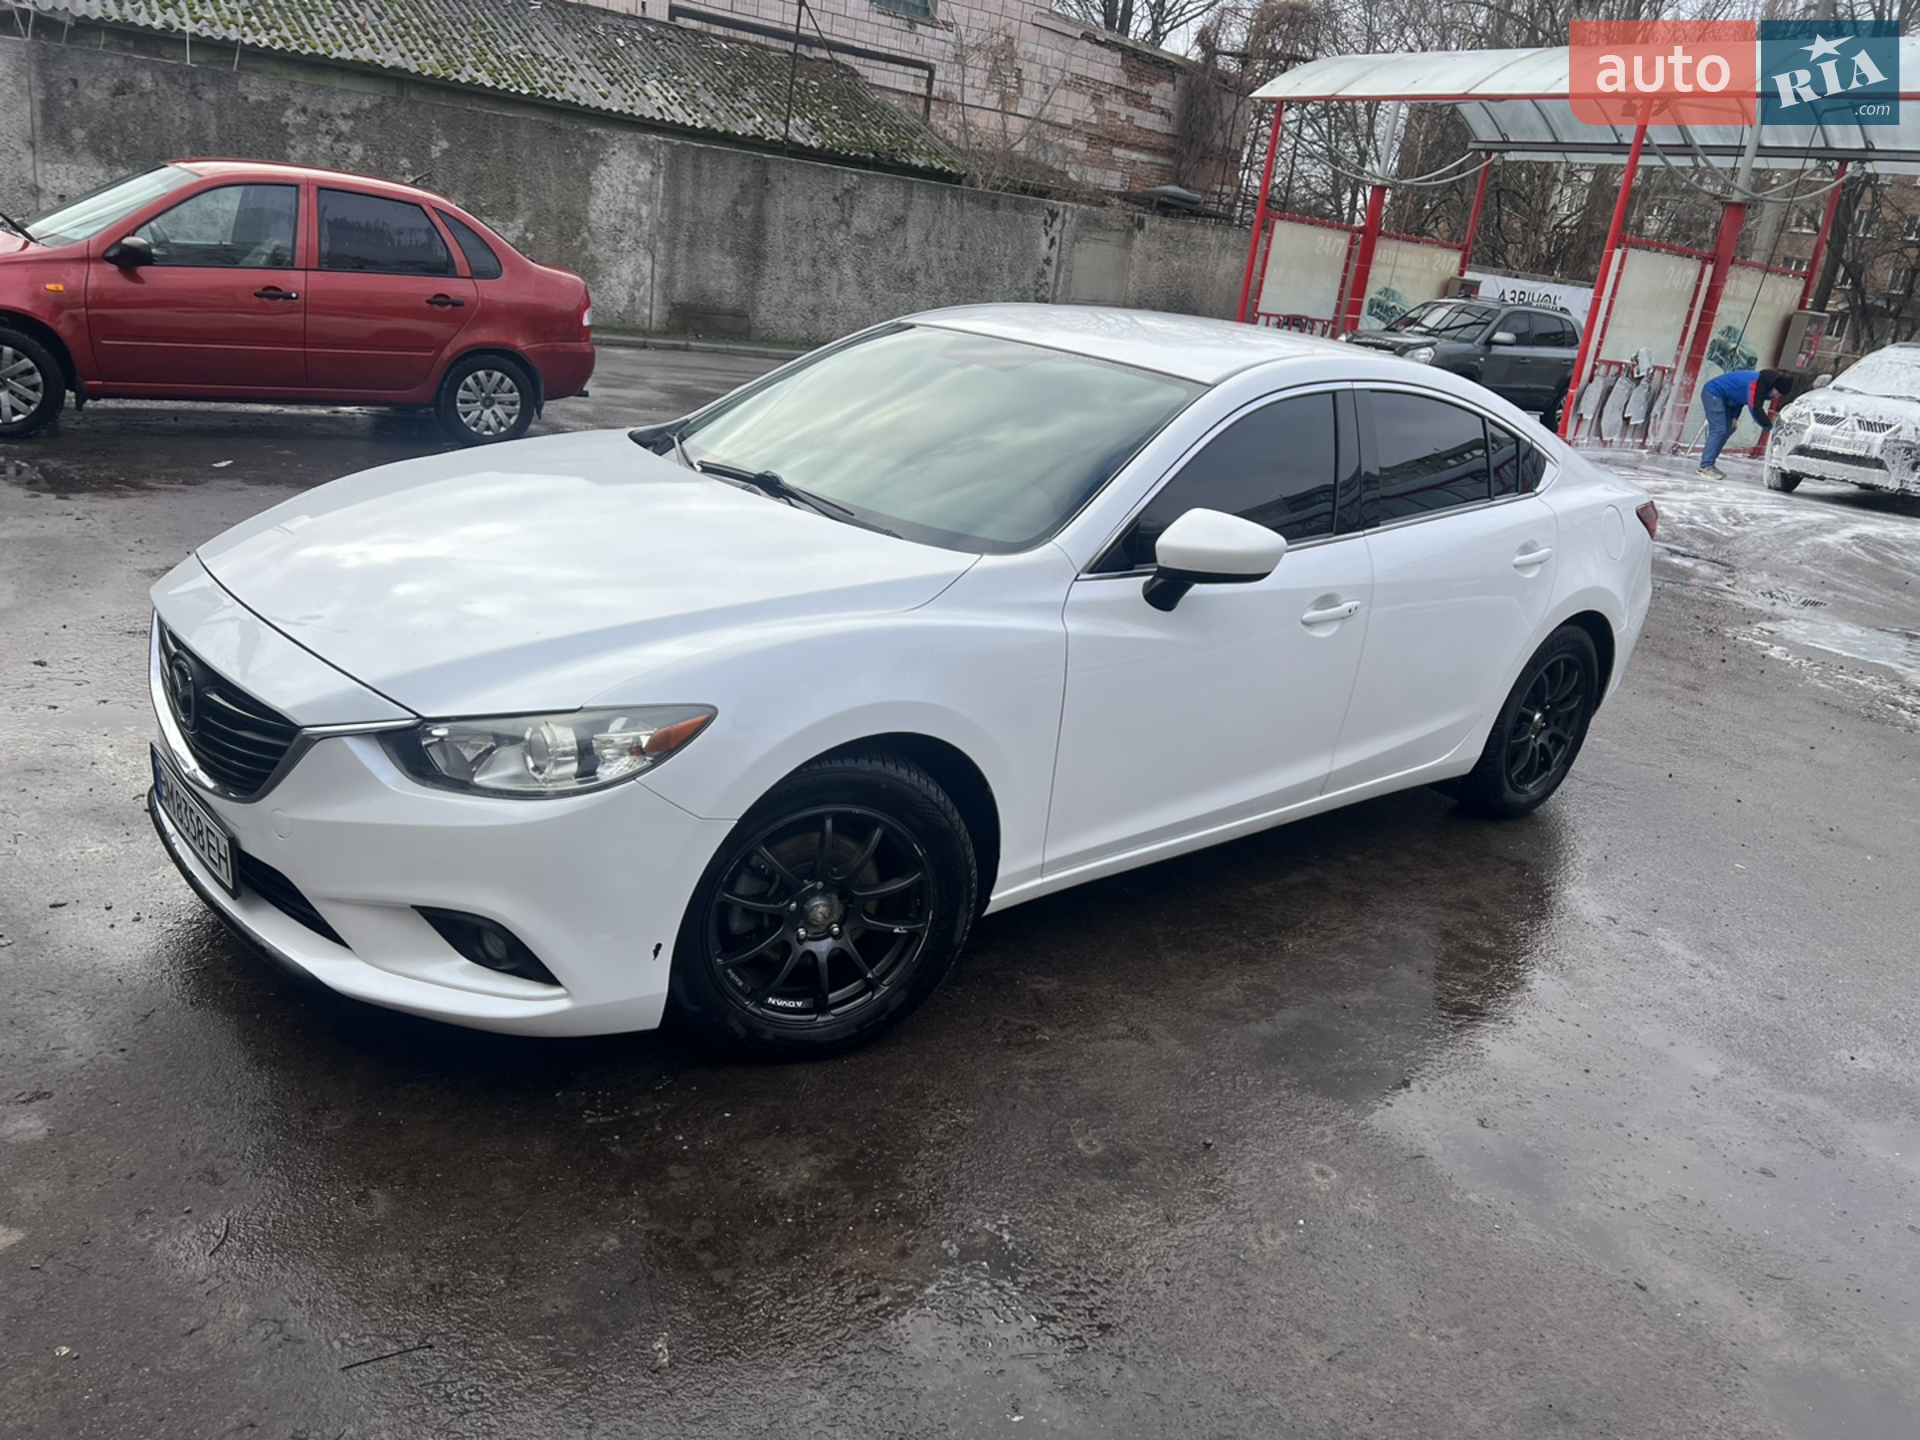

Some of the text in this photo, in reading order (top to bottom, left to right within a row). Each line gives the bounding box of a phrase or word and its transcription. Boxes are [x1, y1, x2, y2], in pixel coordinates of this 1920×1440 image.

[1315, 235, 1345, 257] 24/7
[1432, 253, 1460, 274] 24/7
[1663, 265, 1696, 291] 24/7
[175, 794, 205, 851] 8358
[205, 824, 230, 880] EH
[767, 996, 803, 1008] ADVAN
